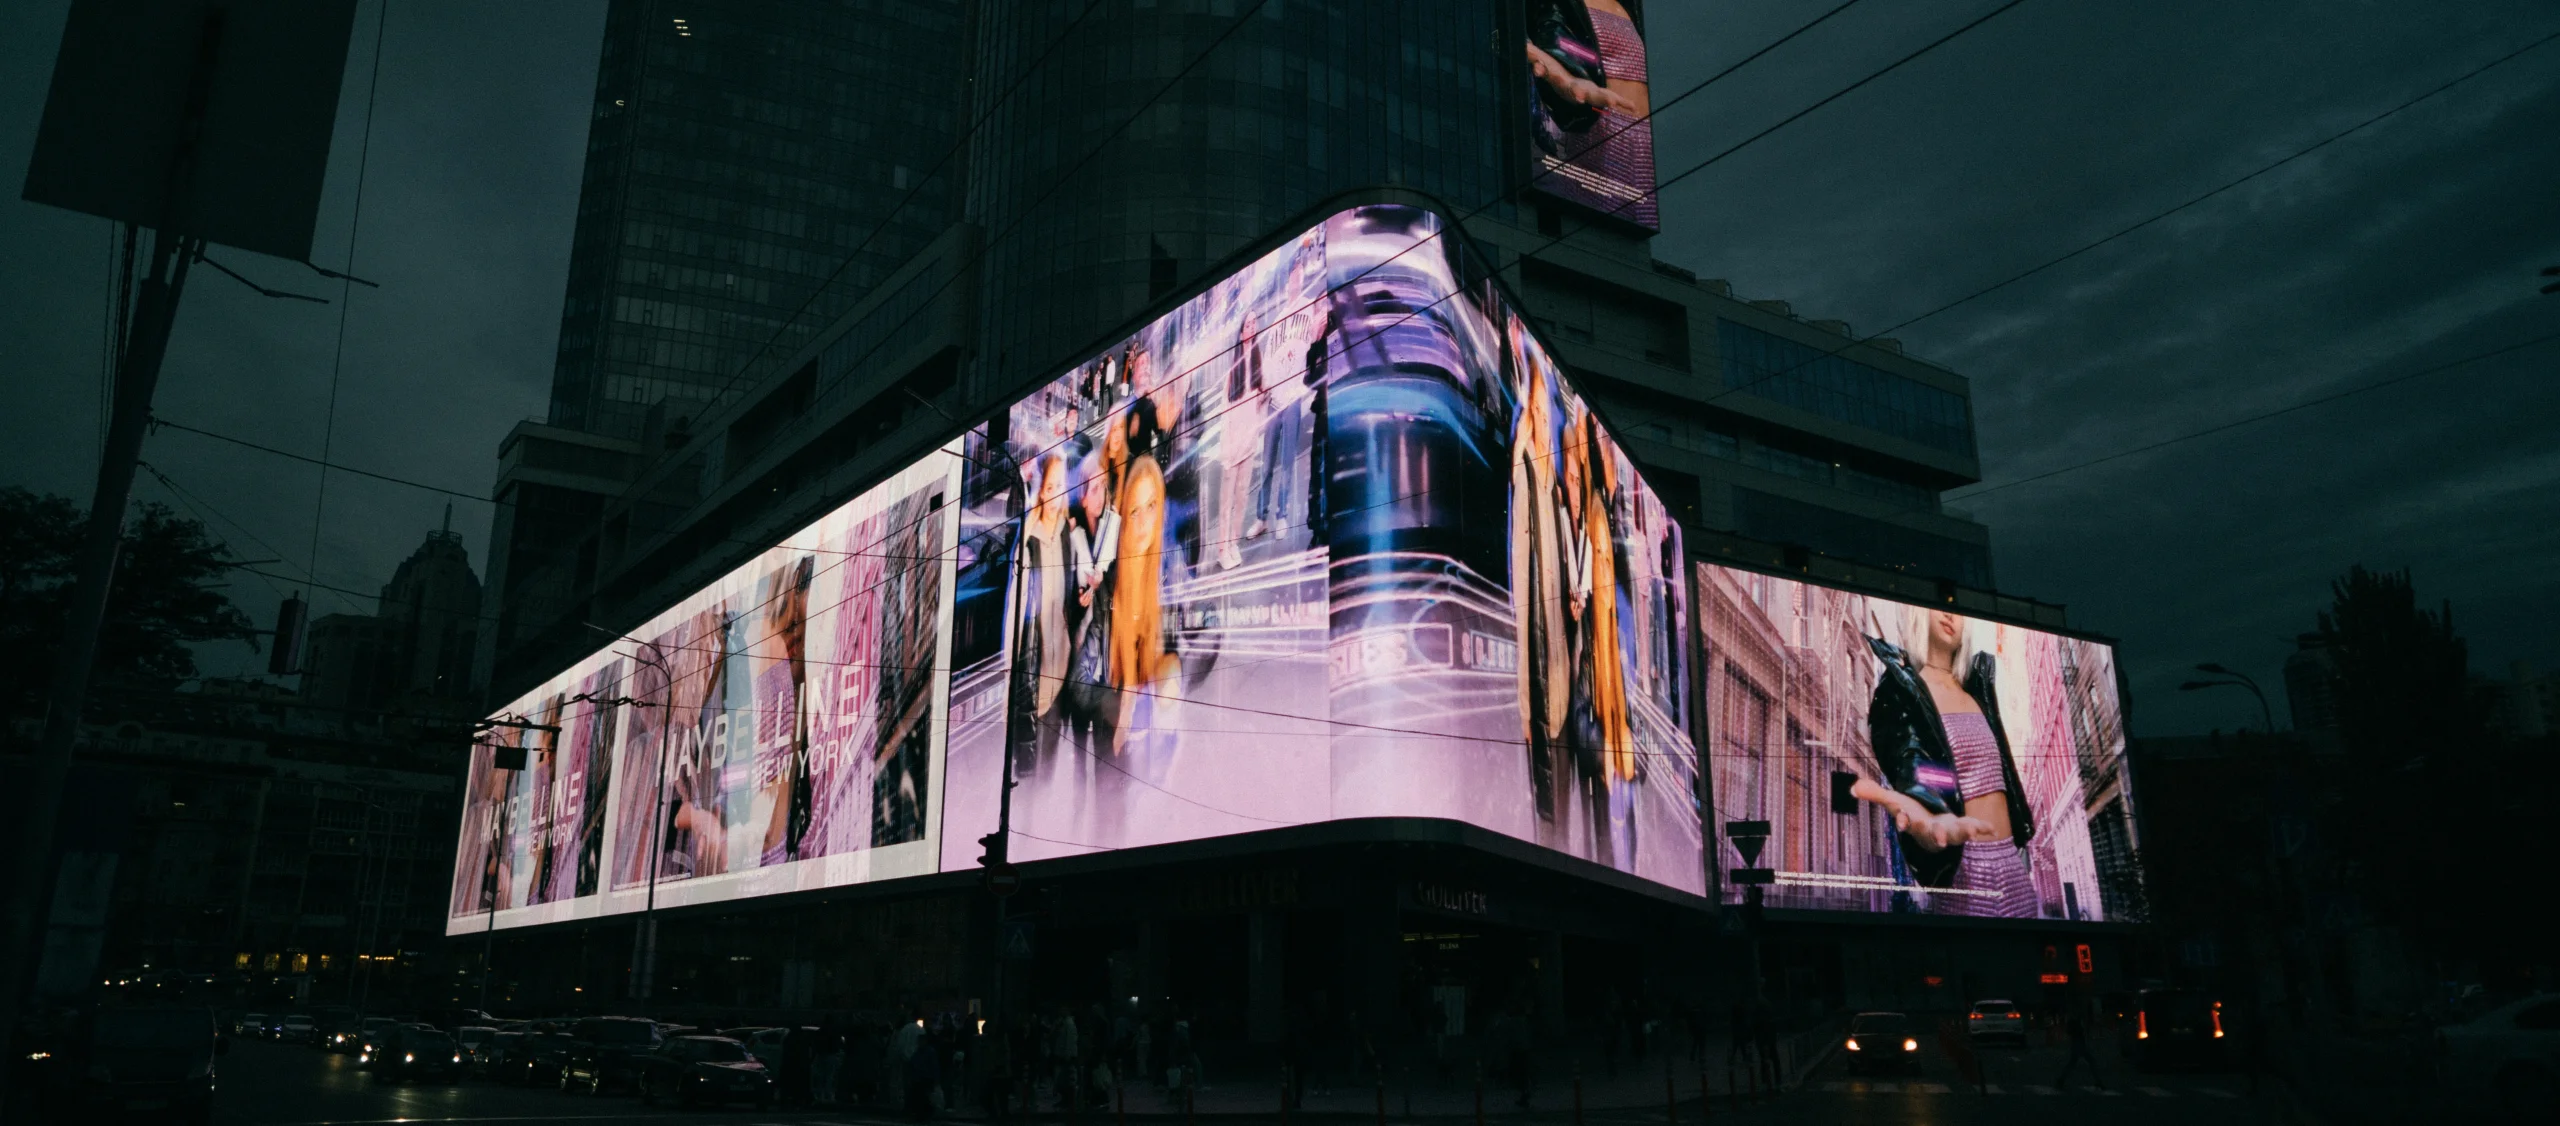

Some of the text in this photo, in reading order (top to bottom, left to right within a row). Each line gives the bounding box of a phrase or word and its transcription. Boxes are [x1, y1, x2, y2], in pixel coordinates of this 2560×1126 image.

[655, 659, 865, 788] MAYBELLINE
[798, 733, 856, 779] YORK
[548, 820, 574, 849] YORK
